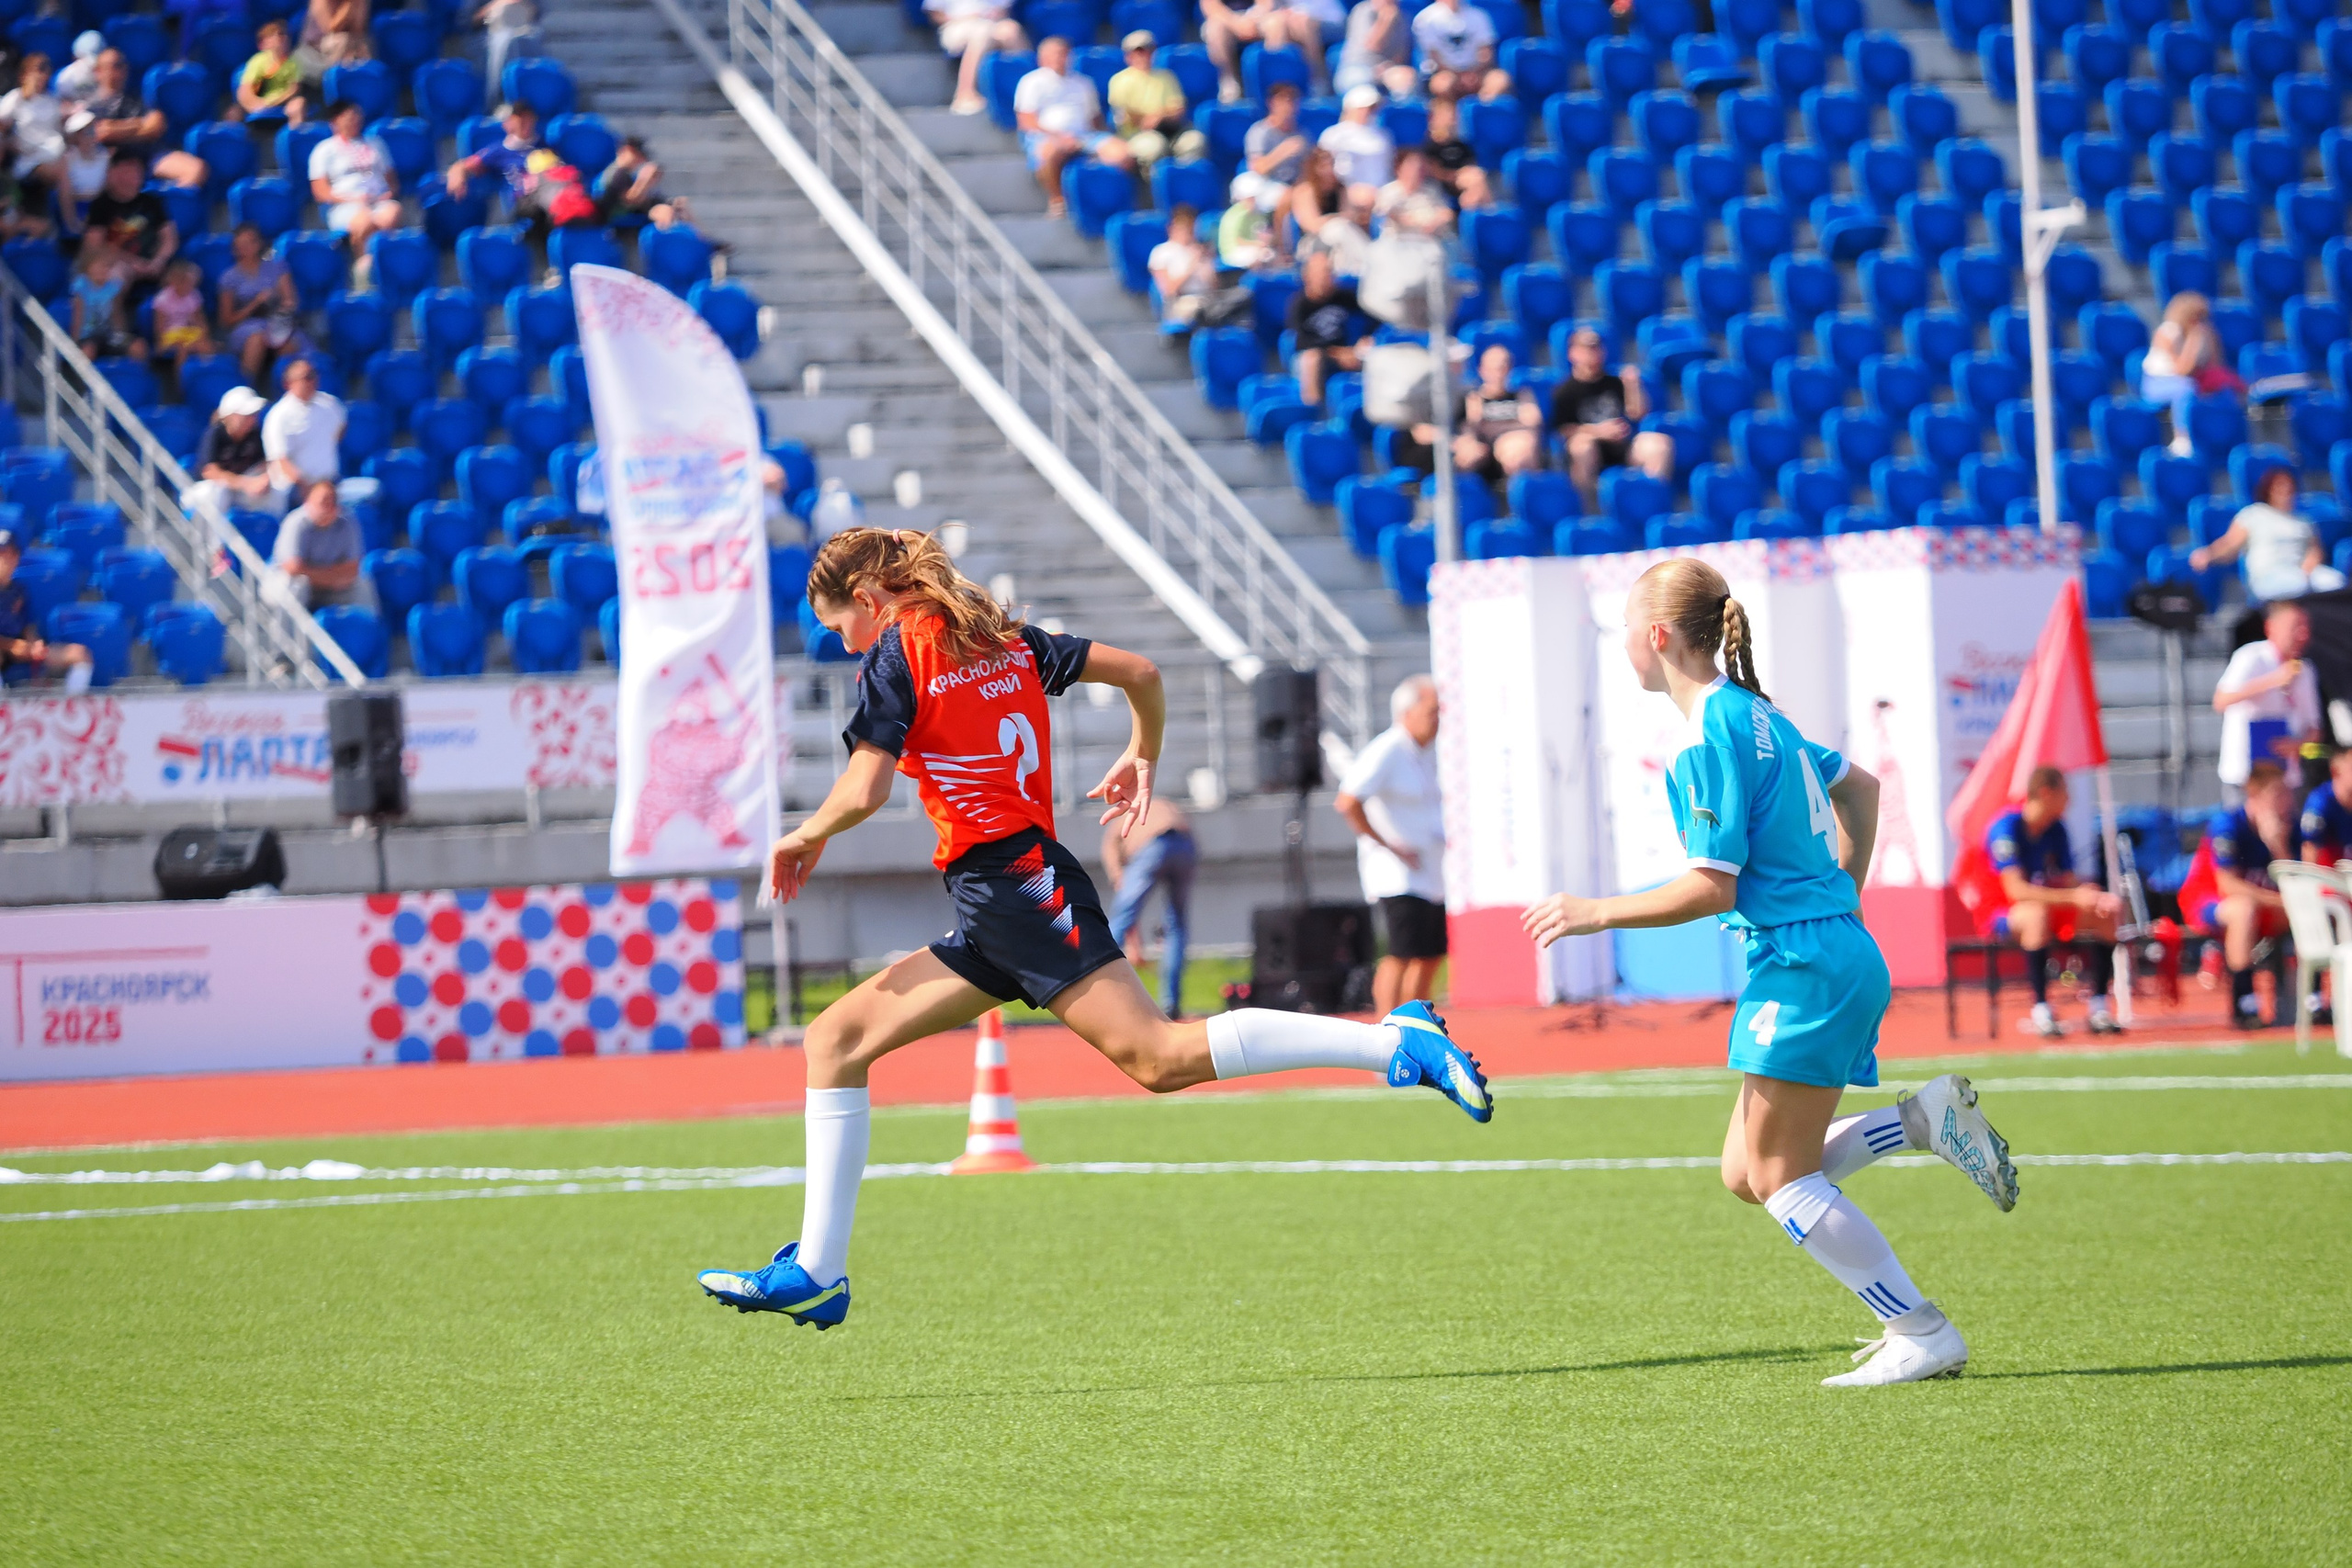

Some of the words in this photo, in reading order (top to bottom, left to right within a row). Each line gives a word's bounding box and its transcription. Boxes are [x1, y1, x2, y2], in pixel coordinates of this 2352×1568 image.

[978, 671, 1023, 701] КРАЙ
[1796, 748, 1839, 862] 4
[41, 972, 211, 1005] КРАСНОЯРСК
[43, 1006, 122, 1046] 2025
[1747, 999, 1781, 1046] 4
